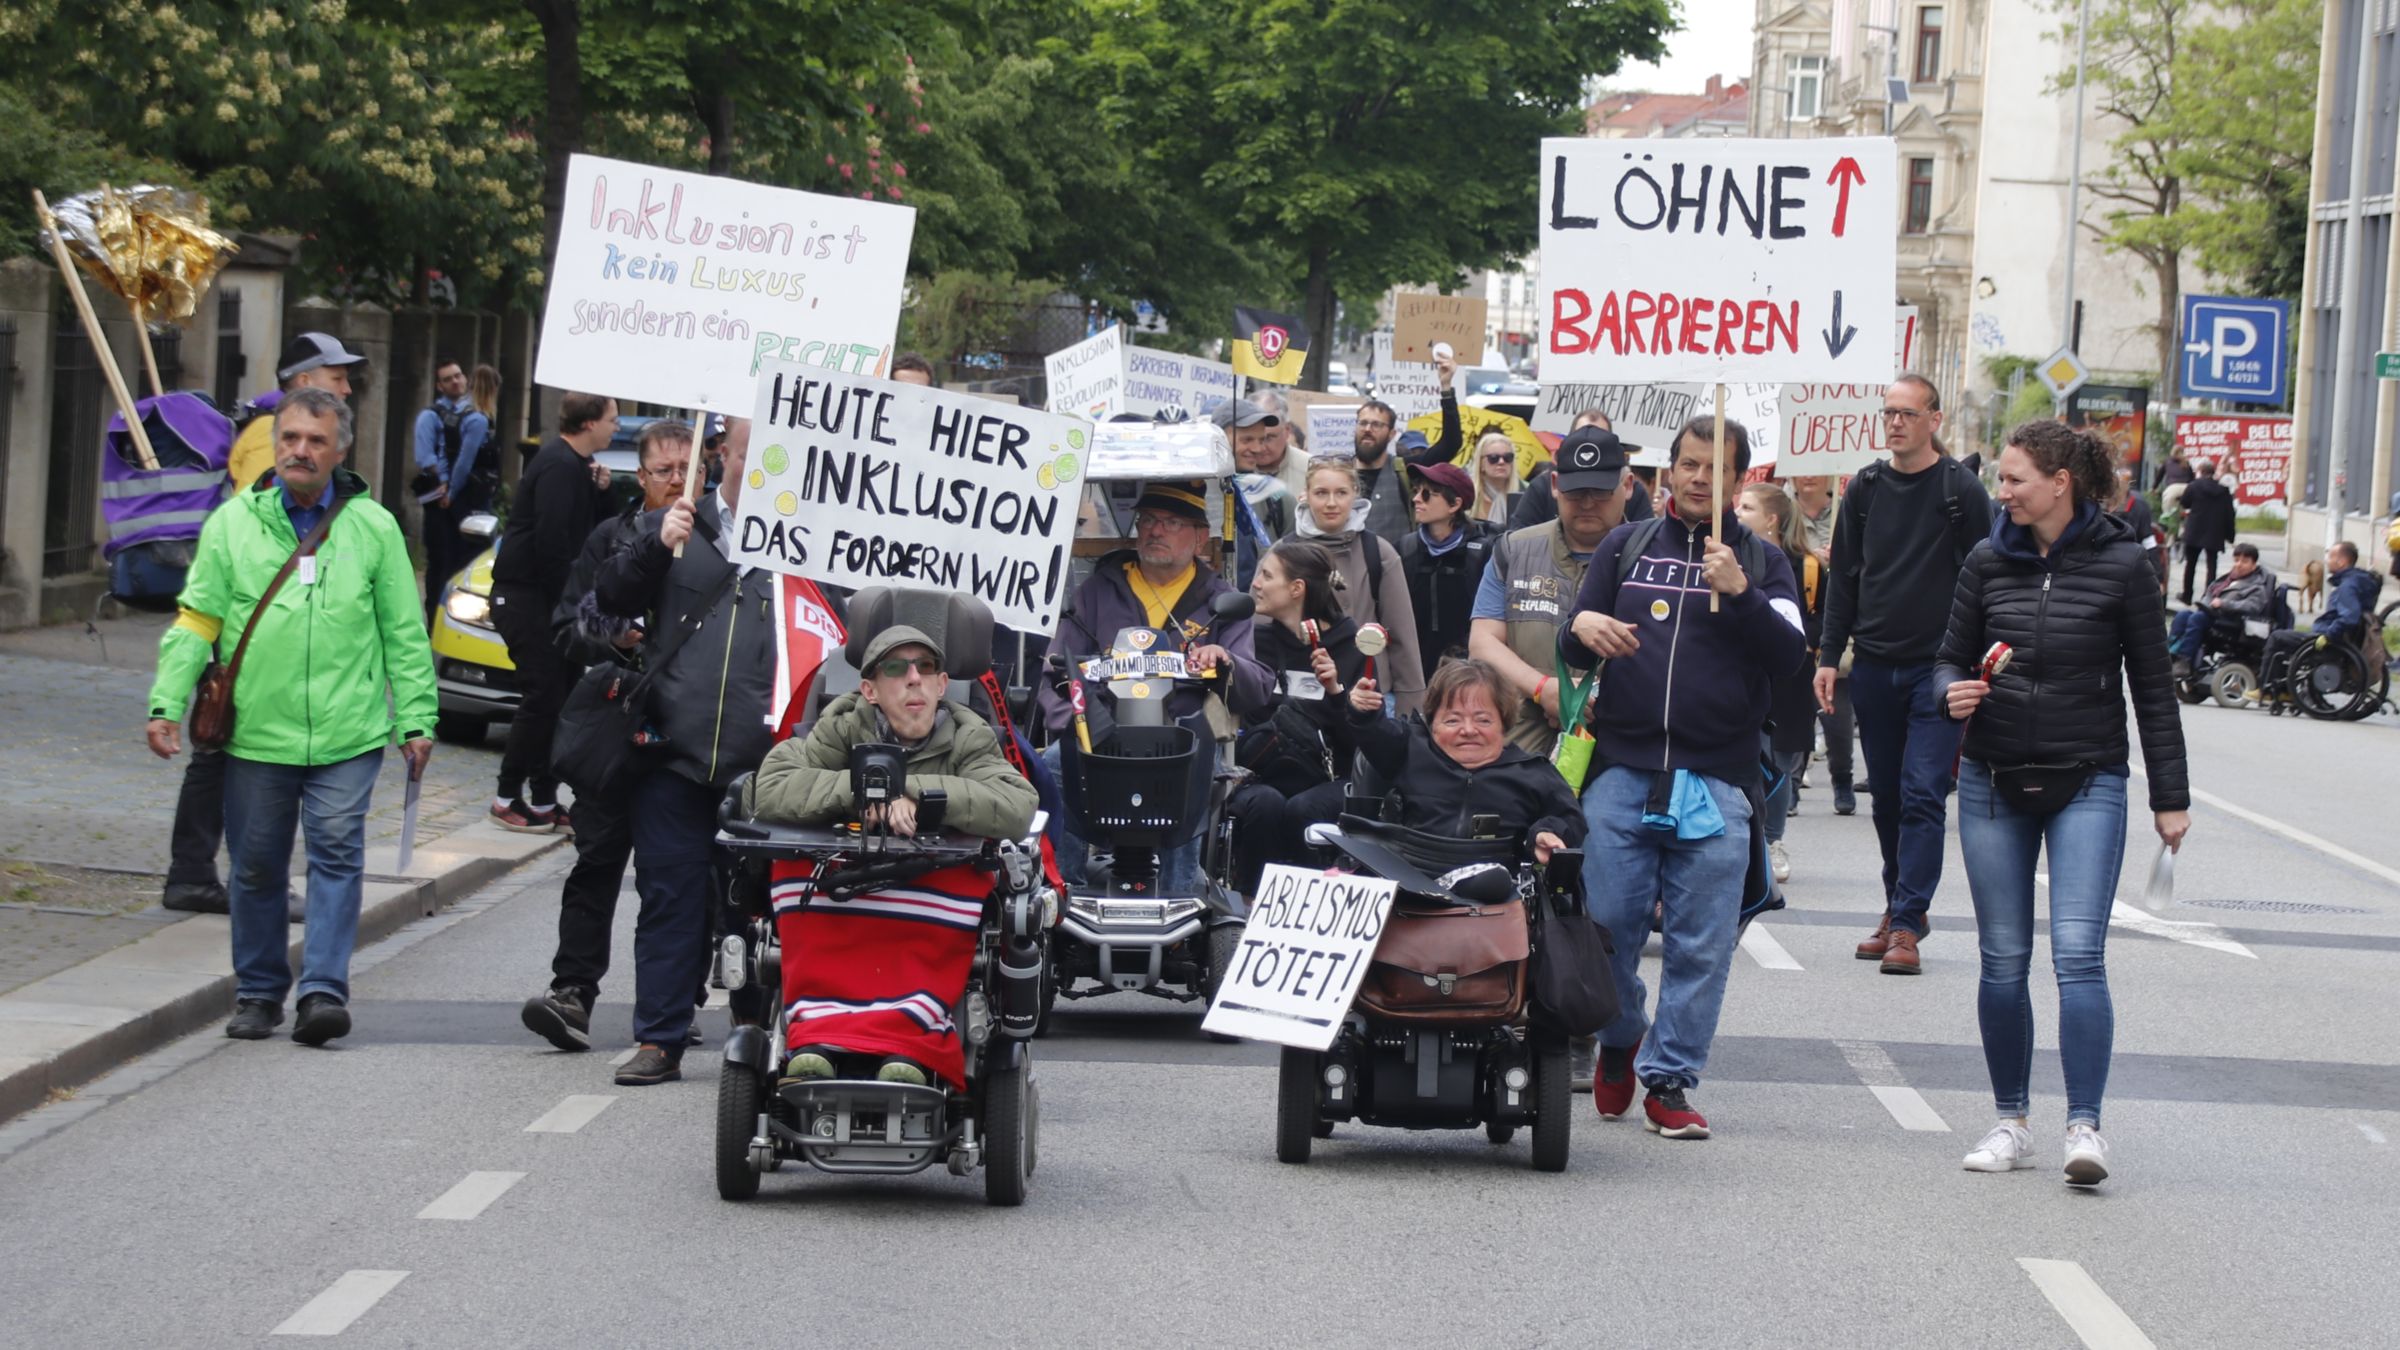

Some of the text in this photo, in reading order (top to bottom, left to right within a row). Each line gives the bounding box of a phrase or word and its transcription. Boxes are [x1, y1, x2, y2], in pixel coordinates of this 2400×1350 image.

[1549, 153, 1810, 239] LÖHNE
[602, 243, 679, 285] kein
[803, 219, 867, 264] ist
[703, 309, 750, 341] ein
[1550, 288, 1799, 356] BARRIEREN
[1052, 334, 1114, 376] INKLUSION
[1130, 353, 1184, 379] BARRIEREN
[2211, 316, 2258, 378] P
[1055, 374, 1074, 394] IST
[1380, 383, 1441, 396] VERSTAN
[769, 372, 897, 446] HEUTE
[930, 405, 1031, 470] HIER
[1790, 411, 1890, 456] ÜBERAL
[801, 445, 1059, 537] INKLUSION
[741, 516, 1063, 628] DAS FORDERN WIR!
[1103, 655, 1143, 678] DYNAMO
[1144, 655, 1183, 674] DRESDEN
[1252, 873, 1391, 941] ABLEISMUS
[1235, 939, 1363, 1003] TÖTET!
